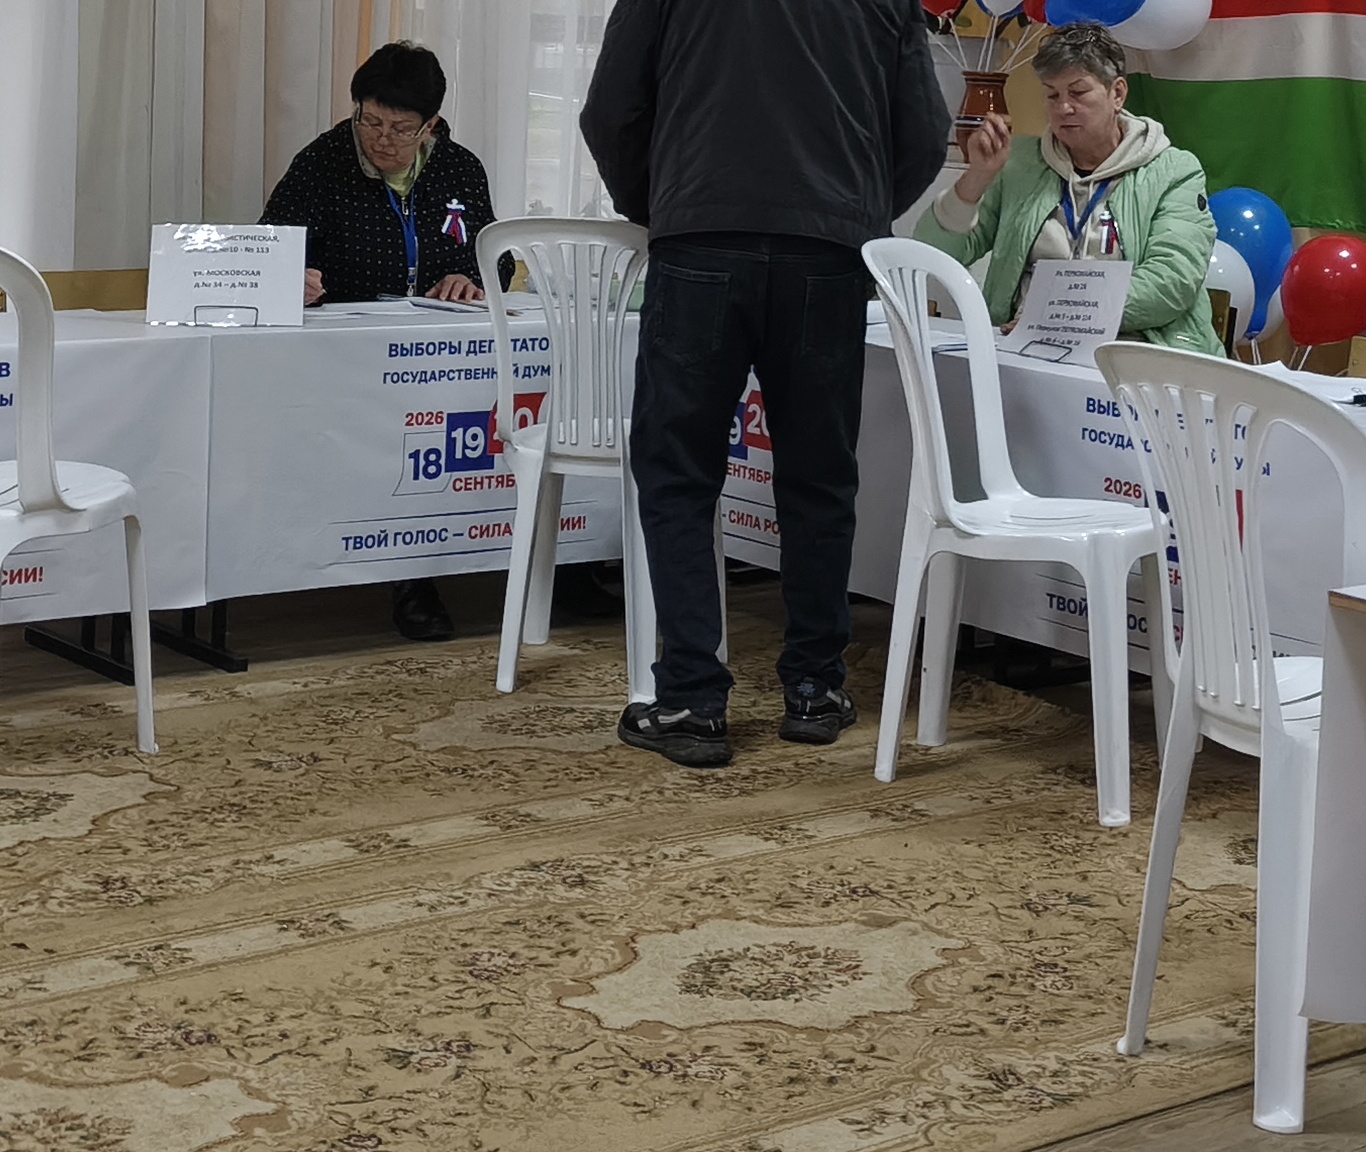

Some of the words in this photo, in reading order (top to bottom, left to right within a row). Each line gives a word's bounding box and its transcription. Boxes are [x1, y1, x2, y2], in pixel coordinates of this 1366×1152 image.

[388, 341, 462, 358] ВЫБОРЫ
[466, 337, 550, 356] ДЕПТАТО
[522, 364, 551, 379] ДУМ
[404, 411, 444, 427] 2026
[451, 426, 485, 460] 19
[408, 447, 443, 481] 18
[727, 462, 773, 484] ЕНТЯБР
[452, 474, 515, 493] СЕНТЯБ
[1104, 477, 1142, 499] 2026
[728, 509, 762, 531] СИЛА
[341, 530, 390, 551] ТВОЙ
[393, 528, 449, 547] ГОЛОС
[468, 522, 514, 540] СИЛА
